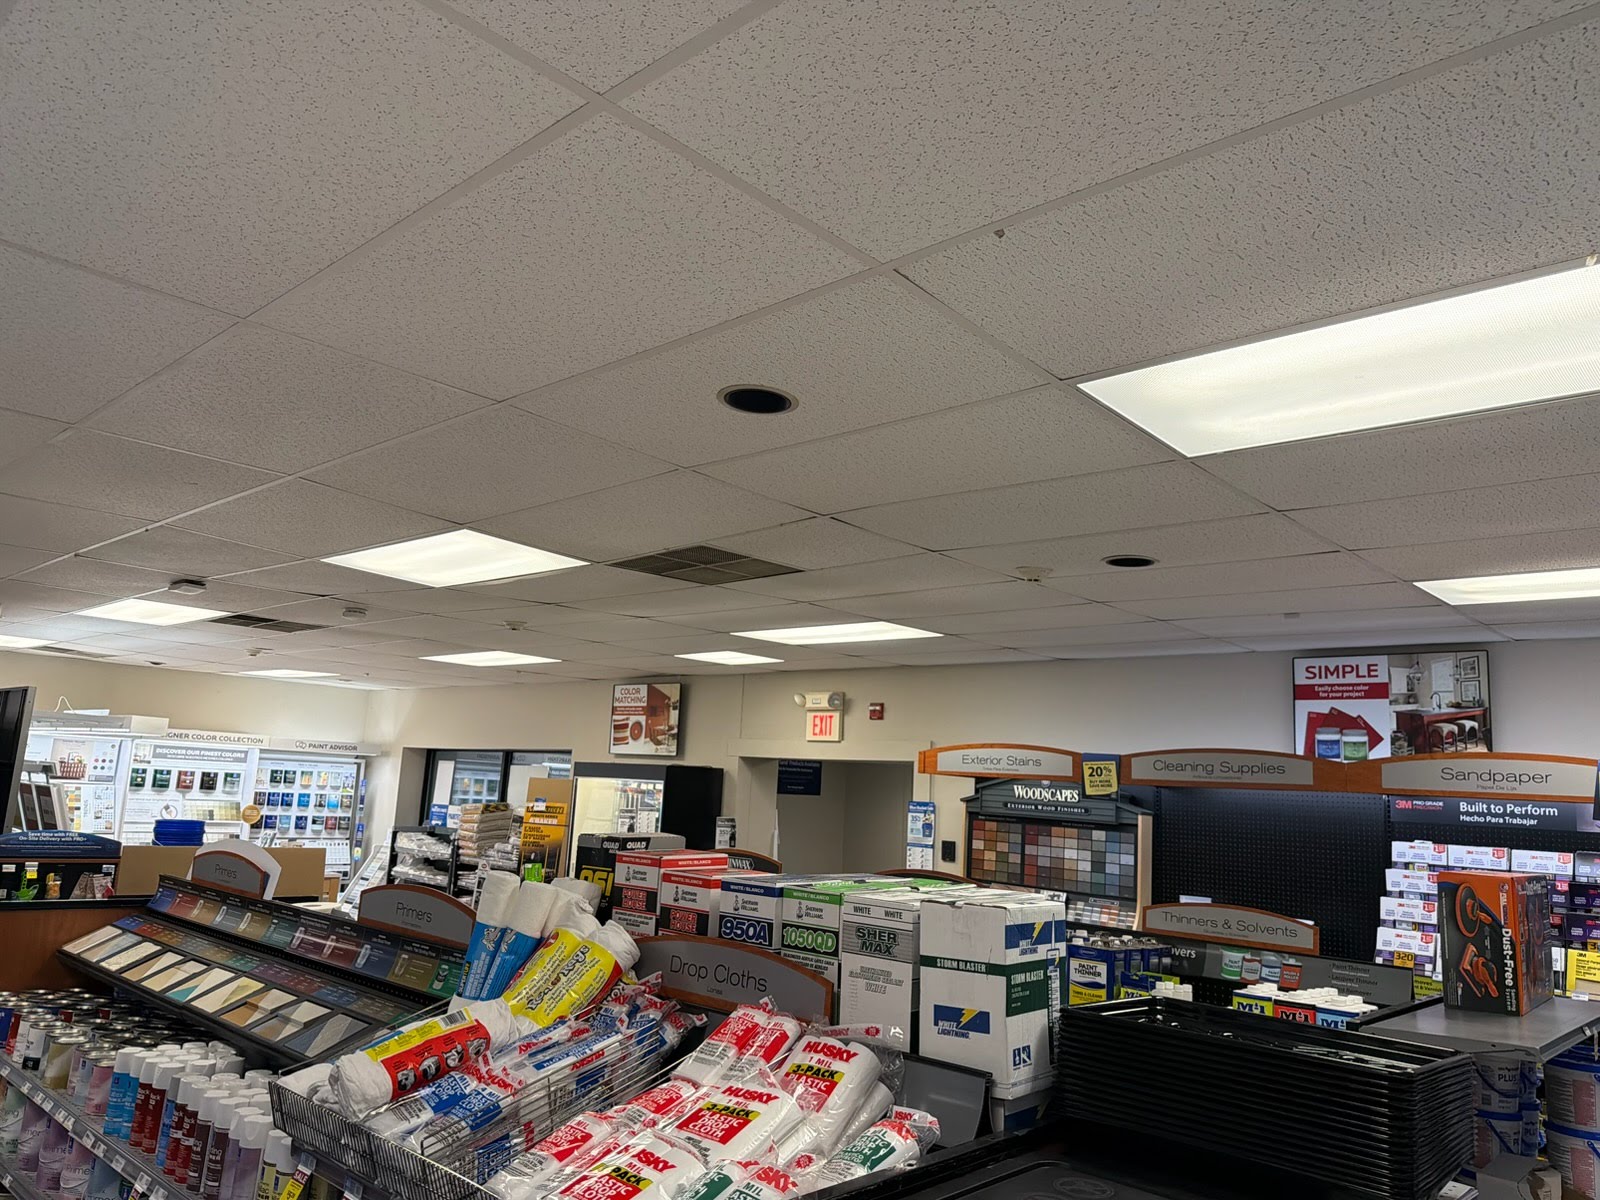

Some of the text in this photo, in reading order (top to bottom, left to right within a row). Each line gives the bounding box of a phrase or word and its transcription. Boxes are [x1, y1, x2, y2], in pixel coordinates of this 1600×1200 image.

[1305, 664, 1378, 680] SIMPLE
[620, 688, 641, 696] COLOR
[1343, 690, 1364, 698] project
[615, 696, 646, 704] MATCHING
[812, 715, 834, 736] EXIT
[192, 733, 216, 741] COLOR
[218, 735, 264, 744] COLLECTION
[156, 748, 186, 756] DISCOVER
[308, 742, 328, 750] PAINT
[962, 754, 1042, 767] Exterior Stains
[1088, 766, 1112, 778] 20%
[1153, 760, 1286, 776] Cleaning Supplies
[1440, 767, 1552, 785] Sandpaper
[1014, 784, 1079, 802] WOODSCAPES
[1038, 804, 1056, 812] WOOD
[1396, 800, 1412, 809] 3M
[1460, 802, 1558, 816] Built to Perform
[1486, 816, 1504, 824] Para
[1505, 817, 1538, 826] Trabajar
[602, 841, 620, 849] QUAD
[626, 840, 646, 849] QUAD
[622, 888, 648, 900] POWER
[730, 884, 764, 894] WHITE/BLANCO
[793, 892, 830, 901] WHITE/BLANCO
[622, 898, 647, 910] HOUSE
[396, 902, 432, 923] Primers
[670, 910, 697, 922] POWER
[854, 906, 871, 915] WHITE
[884, 910, 902, 920] WHITE
[670, 920, 697, 933] HOUSE
[1162, 911, 1218, 928] Thinners
[1223, 919, 1232, 930] &
[1236, 919, 1298, 938] Solvents
[722, 918, 769, 945] 950A
[856, 926, 898, 944] SHER
[783, 926, 836, 953] 1050QD
[861, 941, 896, 956] MAX
[560, 944, 590, 977] Rags
[1395, 952, 1414, 962] 320
[1502, 928, 1514, 986] Dust-Free
[936, 958, 986, 973] STORM BLASTER
[1078, 962, 1098, 970] PAINT
[1348, 964, 1370, 974] Thinner
[670, 955, 768, 992] Drop Cloths
[1011, 970, 1044, 986] STORM BLASTER
[1074, 968, 1102, 978] THINNER
[706, 985, 722, 995] Lonas
[865, 982, 888, 994] WHITE
[938, 1020, 958, 1029] WHITE
[802, 1040, 860, 1063] HUSKY
[814, 1058, 834, 1069] MIL
[792, 1064, 840, 1080] 3-PACK
[457, 1074, 470, 1091] MIL
[788, 1073, 831, 1092] PLASTIC
[486, 1091, 501, 1100] MIL
[722, 1086, 780, 1104] HUSKY
[706, 1103, 754, 1119] 3-PACK
[734, 1100, 750, 1110] MIL
[575, 1120, 590, 1130] MIL
[699, 1110, 744, 1128] PLASTIC
[699, 1118, 730, 1130] DROP
[688, 1122, 723, 1138] CLOTH
[625, 1162, 644, 1174] MIL
[293, 1170, 308, 1184] SALE
[742, 1182, 764, 1196] MIL
